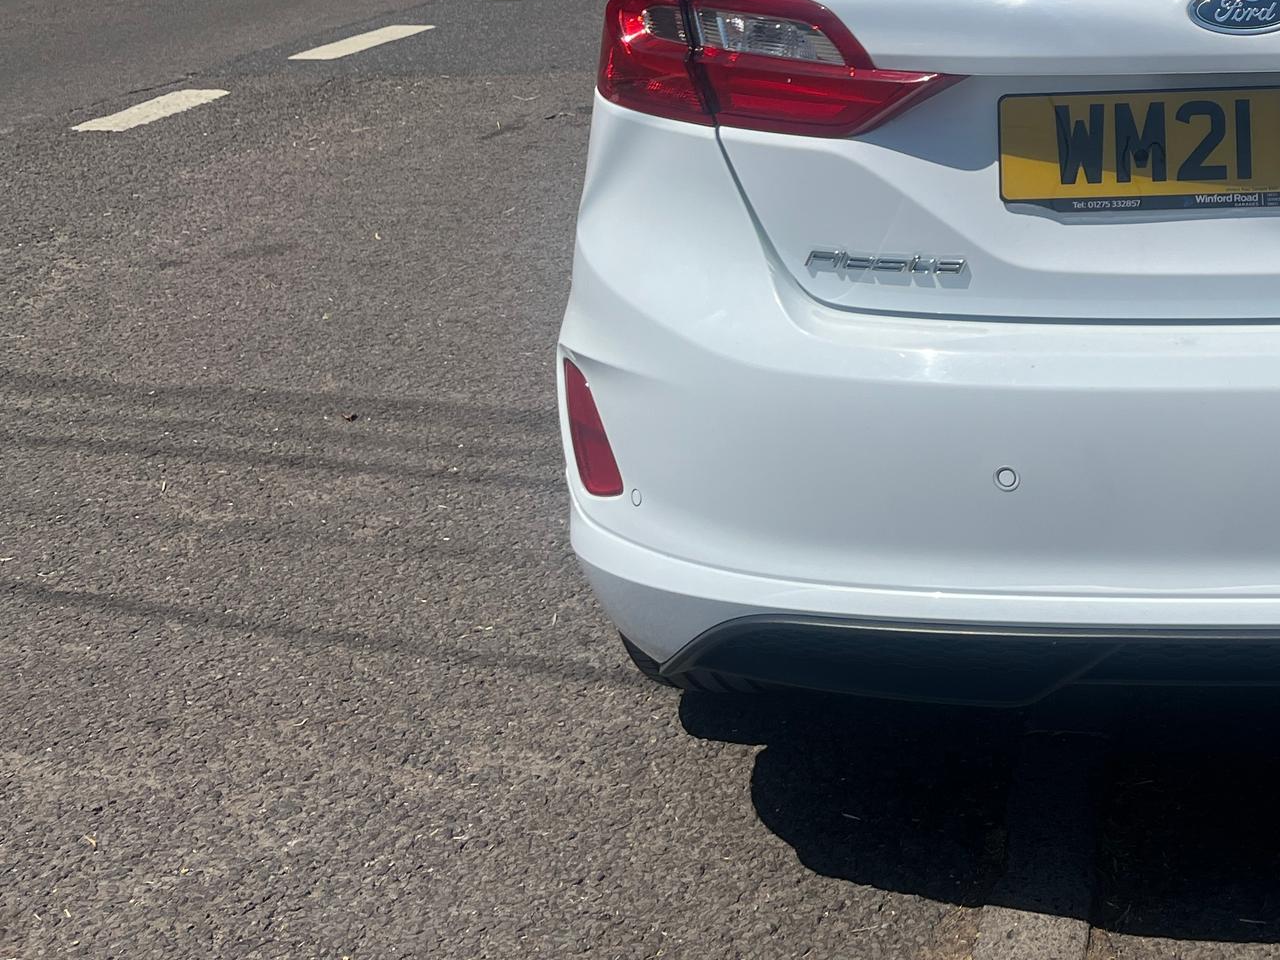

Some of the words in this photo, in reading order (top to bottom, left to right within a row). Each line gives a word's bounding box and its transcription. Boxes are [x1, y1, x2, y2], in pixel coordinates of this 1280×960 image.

[1055, 98, 1252, 185] WM21
[1072, 201, 1087, 209] Tel:
[1088, 200, 1111, 209] 01275
[1112, 199, 1141, 208] 332857
[1195, 194, 1233, 204] Winford
[1233, 193, 1259, 202] Road
